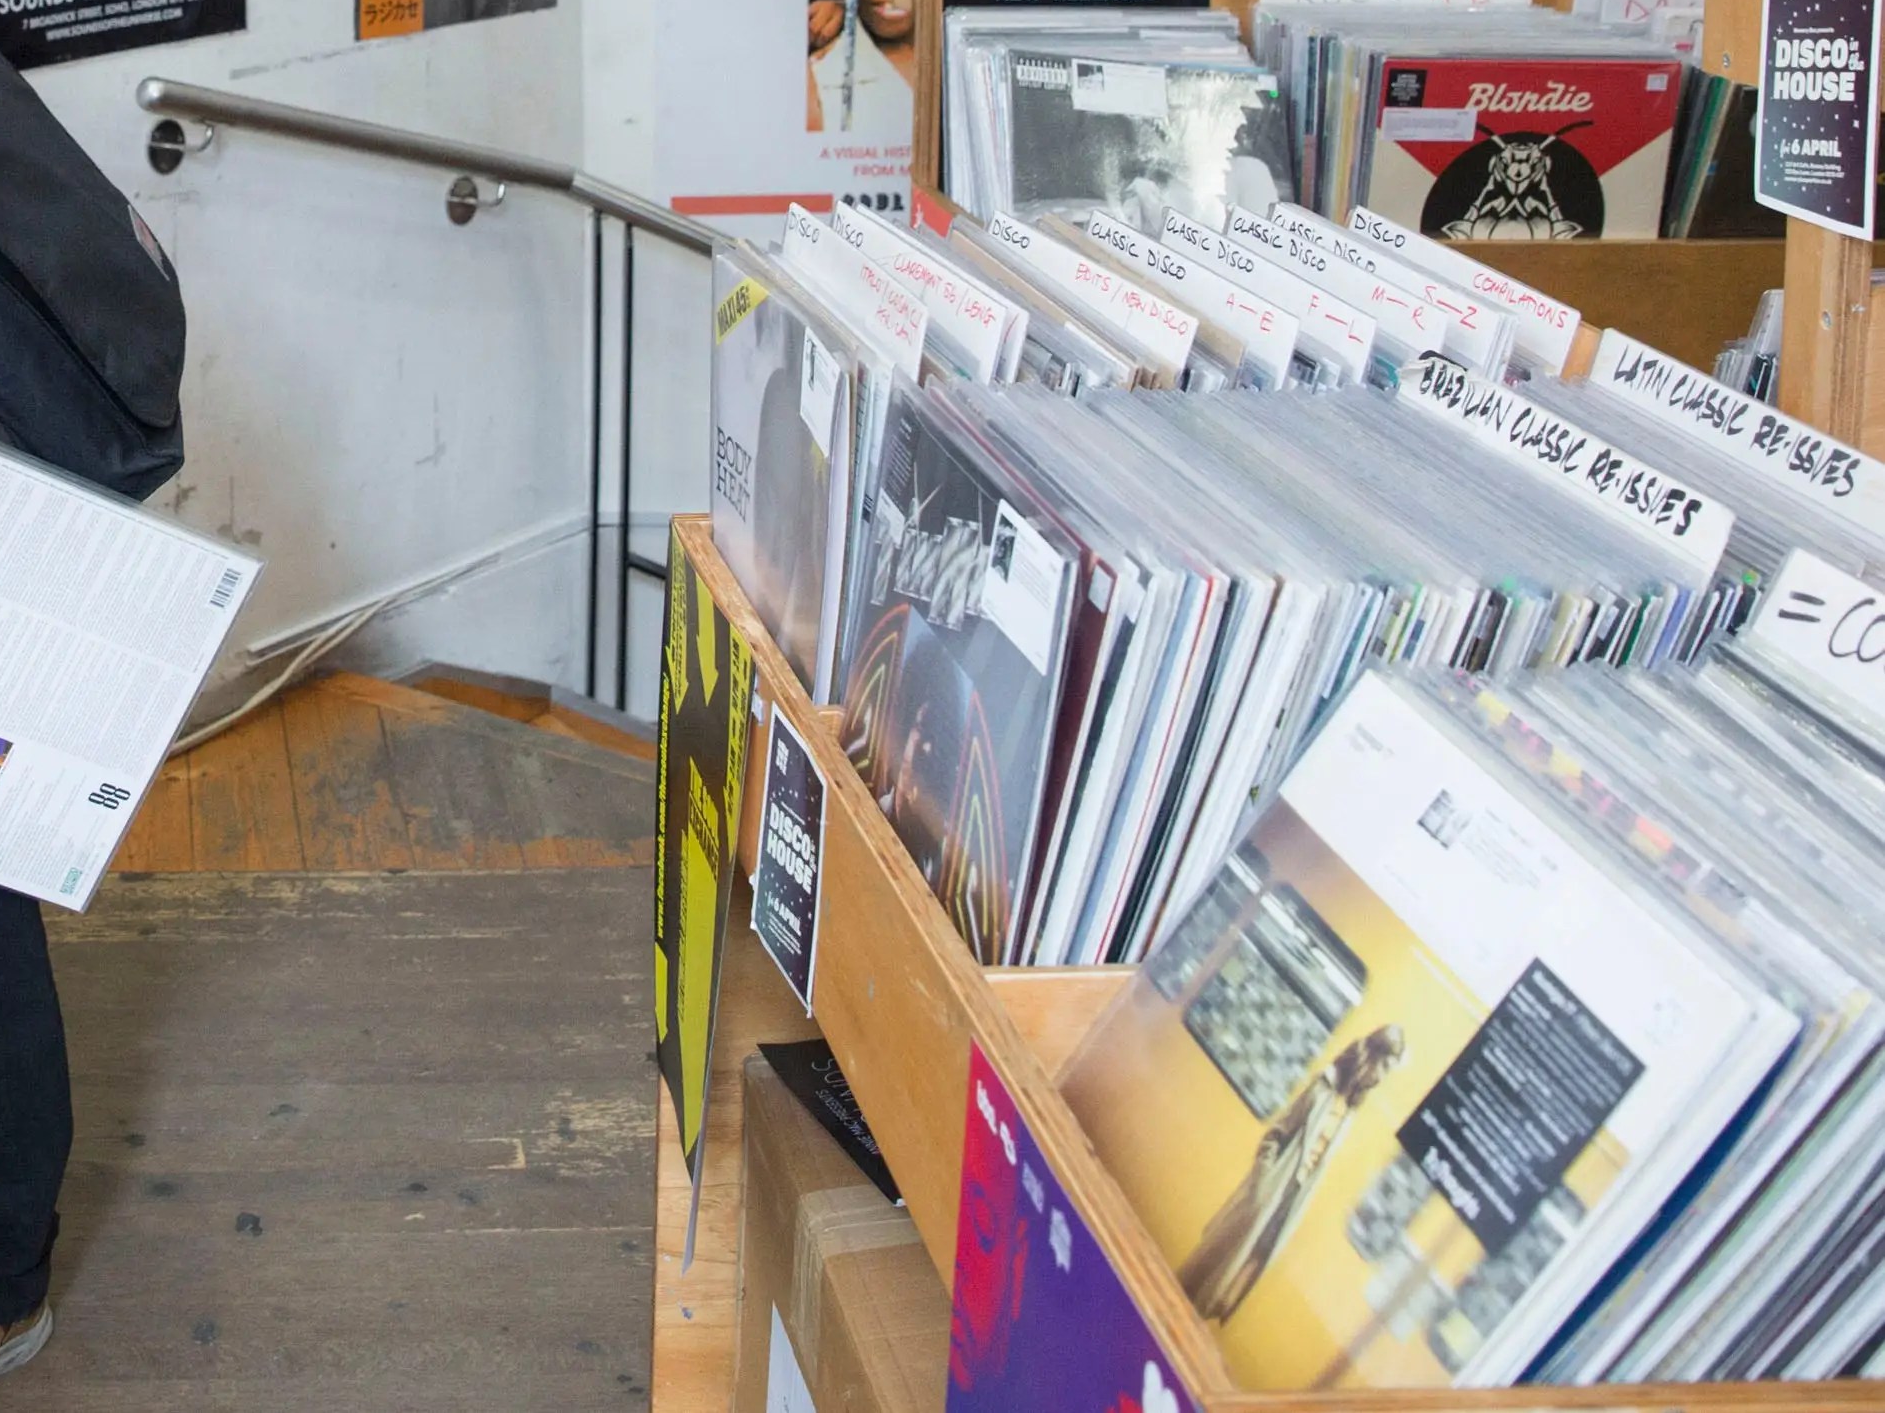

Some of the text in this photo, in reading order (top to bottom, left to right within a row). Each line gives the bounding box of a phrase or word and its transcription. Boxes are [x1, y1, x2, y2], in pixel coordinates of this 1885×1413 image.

[1775, 37, 1850, 70] DISCO
[1464, 81, 1595, 114] Blondie
[1772, 71, 1856, 103] HOUSE
[833, 145, 880, 161] VISUAL
[882, 145, 914, 161] HIST
[1791, 138, 1843, 159] 6 APRIL
[853, 163, 897, 179] FROM
[787, 210, 820, 244] DISCO
[835, 212, 865, 249] DISCO
[991, 218, 1031, 250] DISCO
[1164, 212, 1256, 275] CLASSIC DISCO
[1233, 214, 1328, 274] CLASSIC DISCO
[1352, 211, 1408, 250] DISCO
[1090, 211, 1189, 283] CLASSIC DISCO
[1074, 261, 1112, 294] EDITS
[1150, 299, 1191, 337] DISCO
[1471, 270, 1570, 332] COMPILATIONS
[1612, 345, 1665, 400] LATIN
[1668, 370, 1747, 436] CLASSIC
[1419, 360, 1506, 433] BRAZILIAN
[1509, 405, 1587, 475] CLASSIC
[715, 427, 752, 477] BODY
[715, 467, 752, 524] HEAT
[769, 802, 812, 863] DISCO
[765, 828, 814, 896] HOUSE
